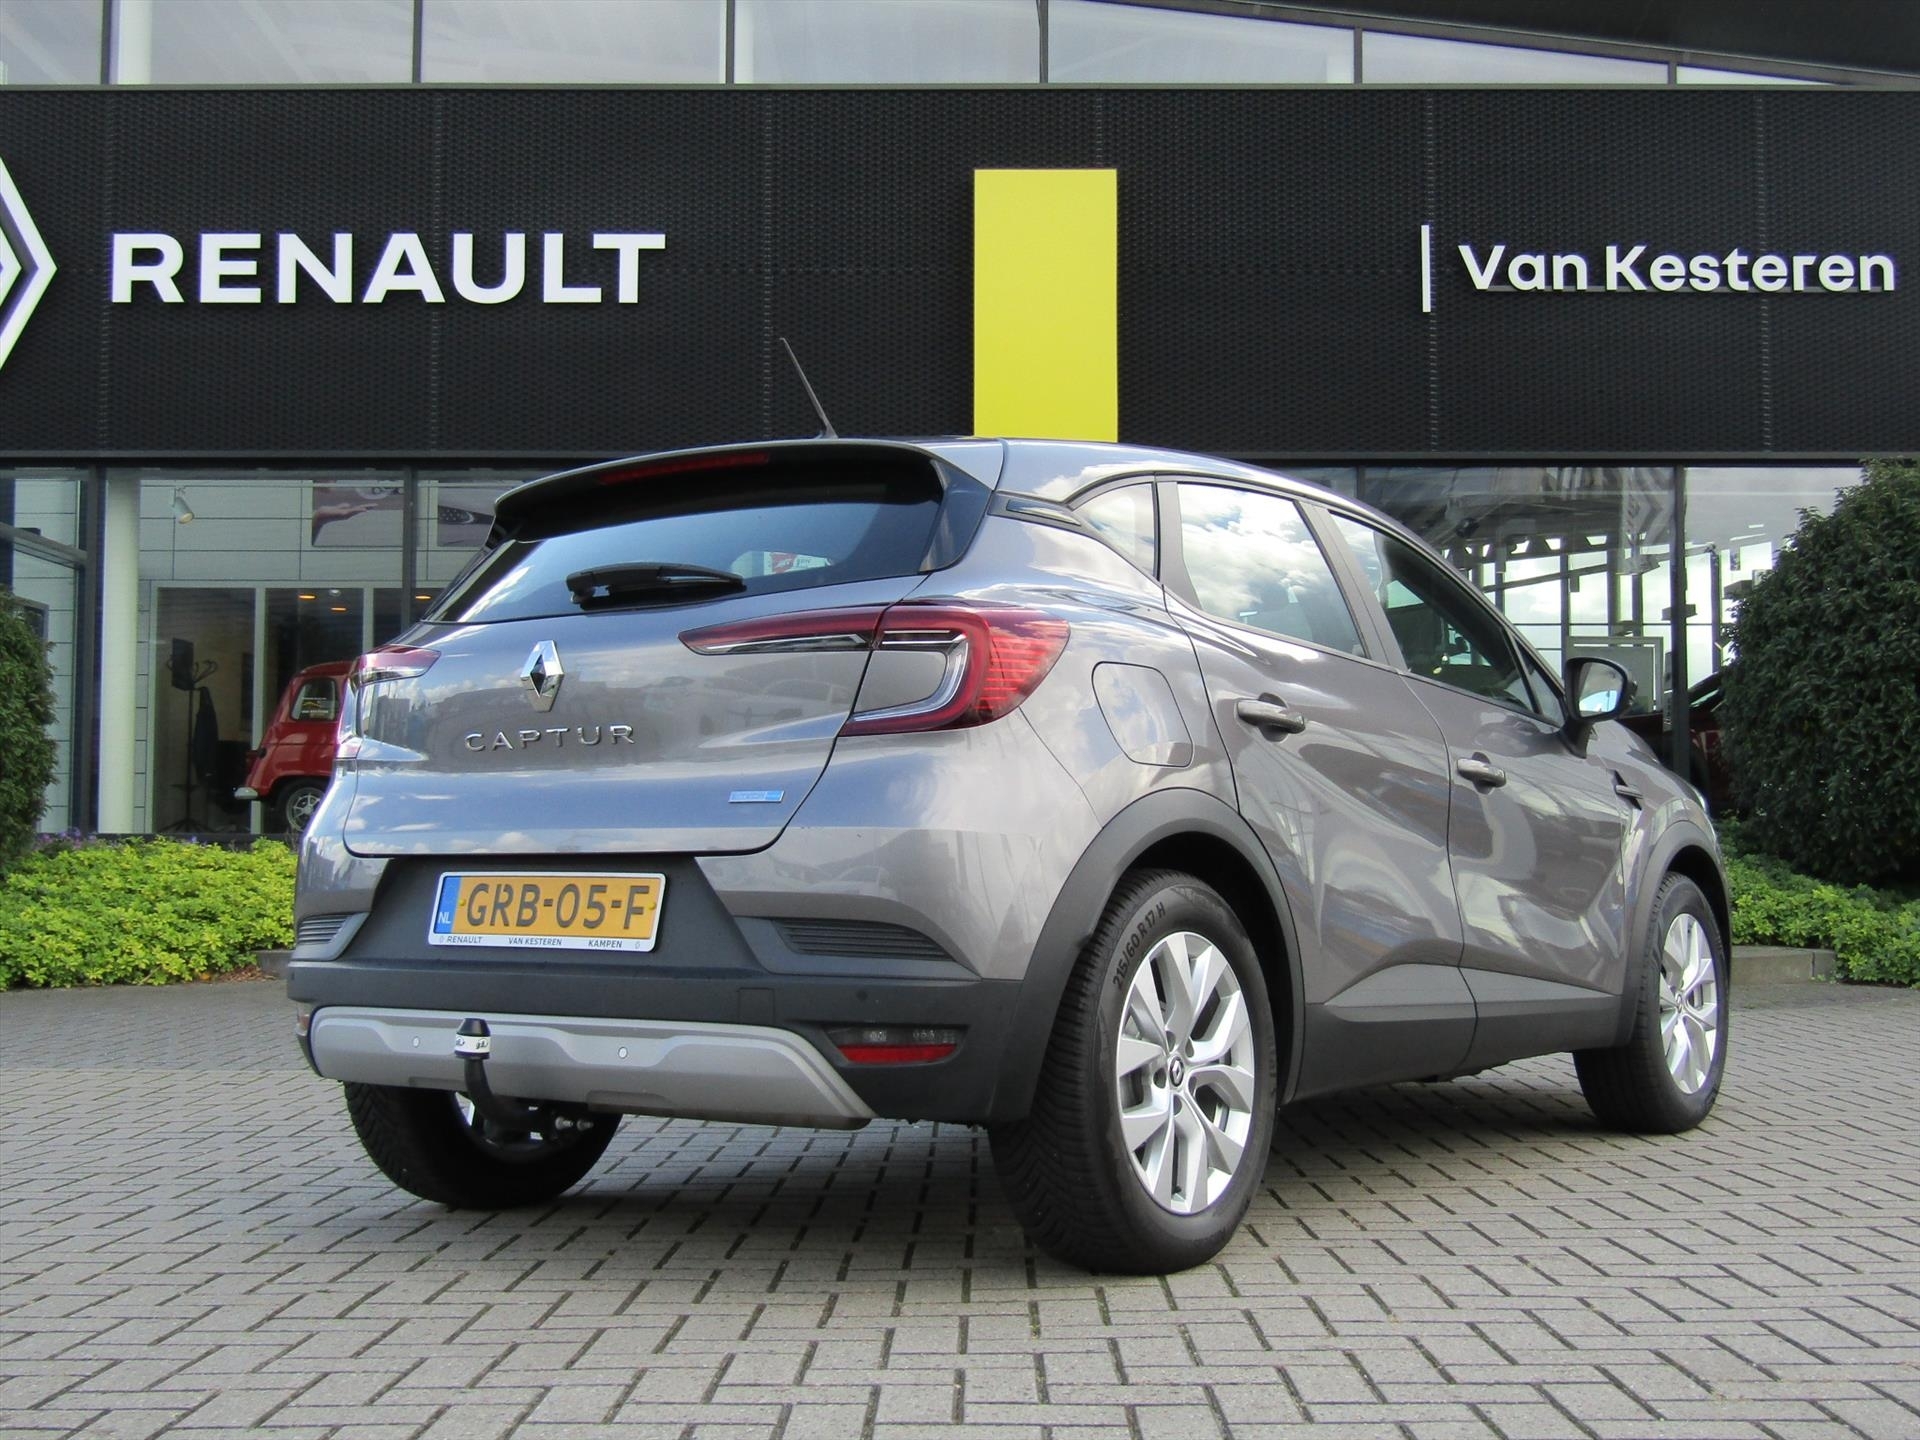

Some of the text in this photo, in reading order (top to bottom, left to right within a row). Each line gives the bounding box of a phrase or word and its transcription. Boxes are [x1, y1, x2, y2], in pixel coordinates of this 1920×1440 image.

[111, 232, 666, 304] RENAULT
[1458, 244, 1896, 293] Van Kesteren
[464, 725, 636, 752] CAPTUR
[438, 912, 451, 924] NL
[467, 883, 649, 930] GRB-05-F
[446, 935, 622, 948] RENAULT VAN KESTEREN KAMPEN
